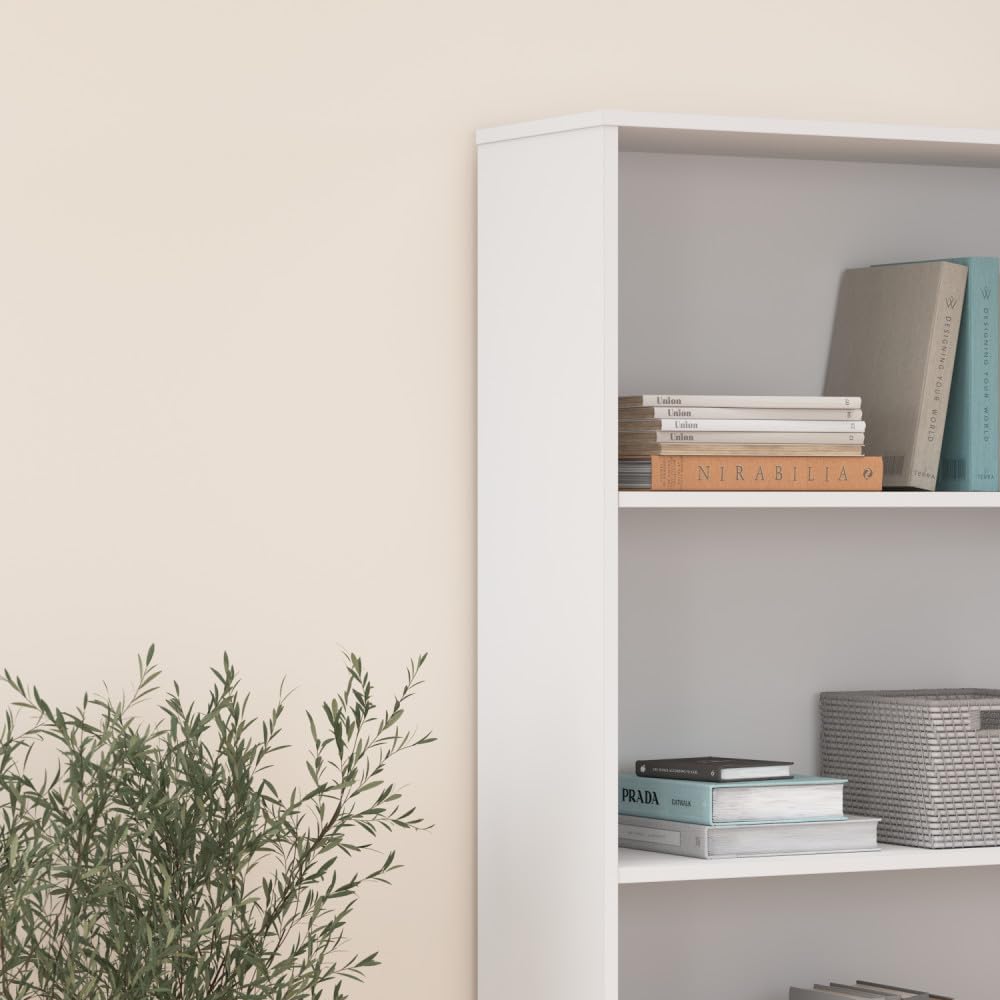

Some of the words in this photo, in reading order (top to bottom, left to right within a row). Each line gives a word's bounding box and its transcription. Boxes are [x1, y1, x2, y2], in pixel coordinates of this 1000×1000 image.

[938, 315, 952, 370] DESIGNING
[933, 376, 944, 401] YOUR
[656, 396, 682, 405] Union
[667, 408, 692, 417] Union
[674, 420, 698, 429] Union
[927, 409, 939, 442] WORLD
[670, 432, 694, 441] Union
[622, 787, 660, 806] PRADA
